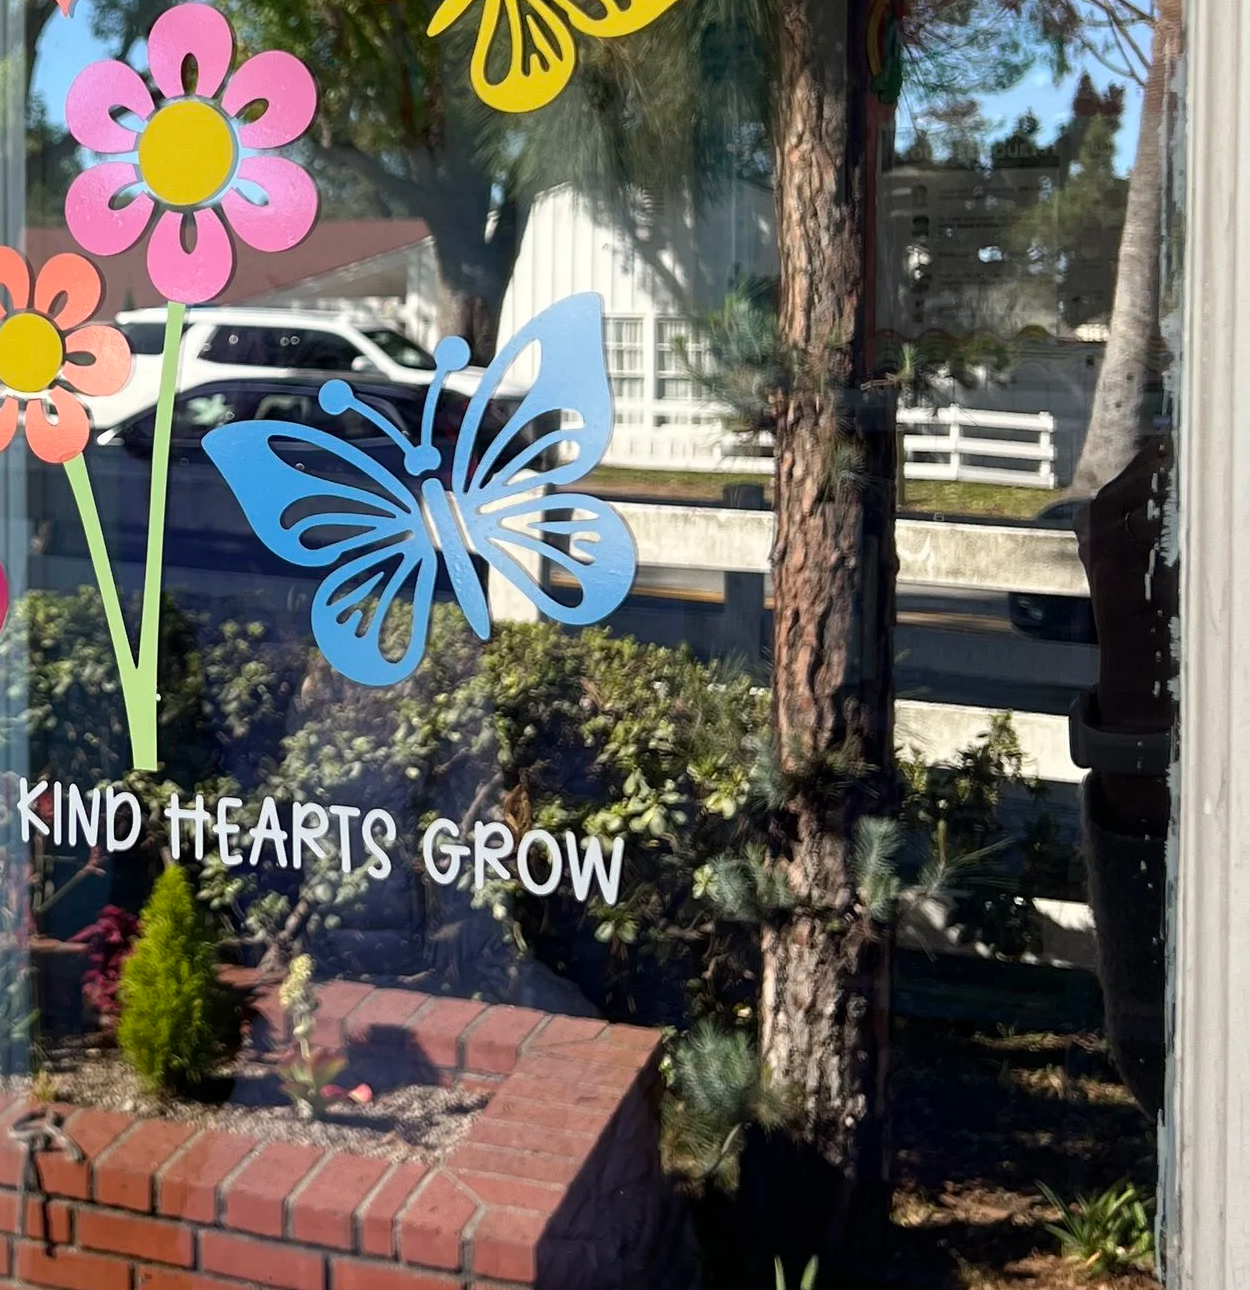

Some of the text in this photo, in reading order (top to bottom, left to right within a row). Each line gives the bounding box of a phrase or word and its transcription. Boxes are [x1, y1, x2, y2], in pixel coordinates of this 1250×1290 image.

[18, 780, 141, 851] KIND
[165, 791, 397, 879] HEARTS
[423, 817, 624, 905] GROW
